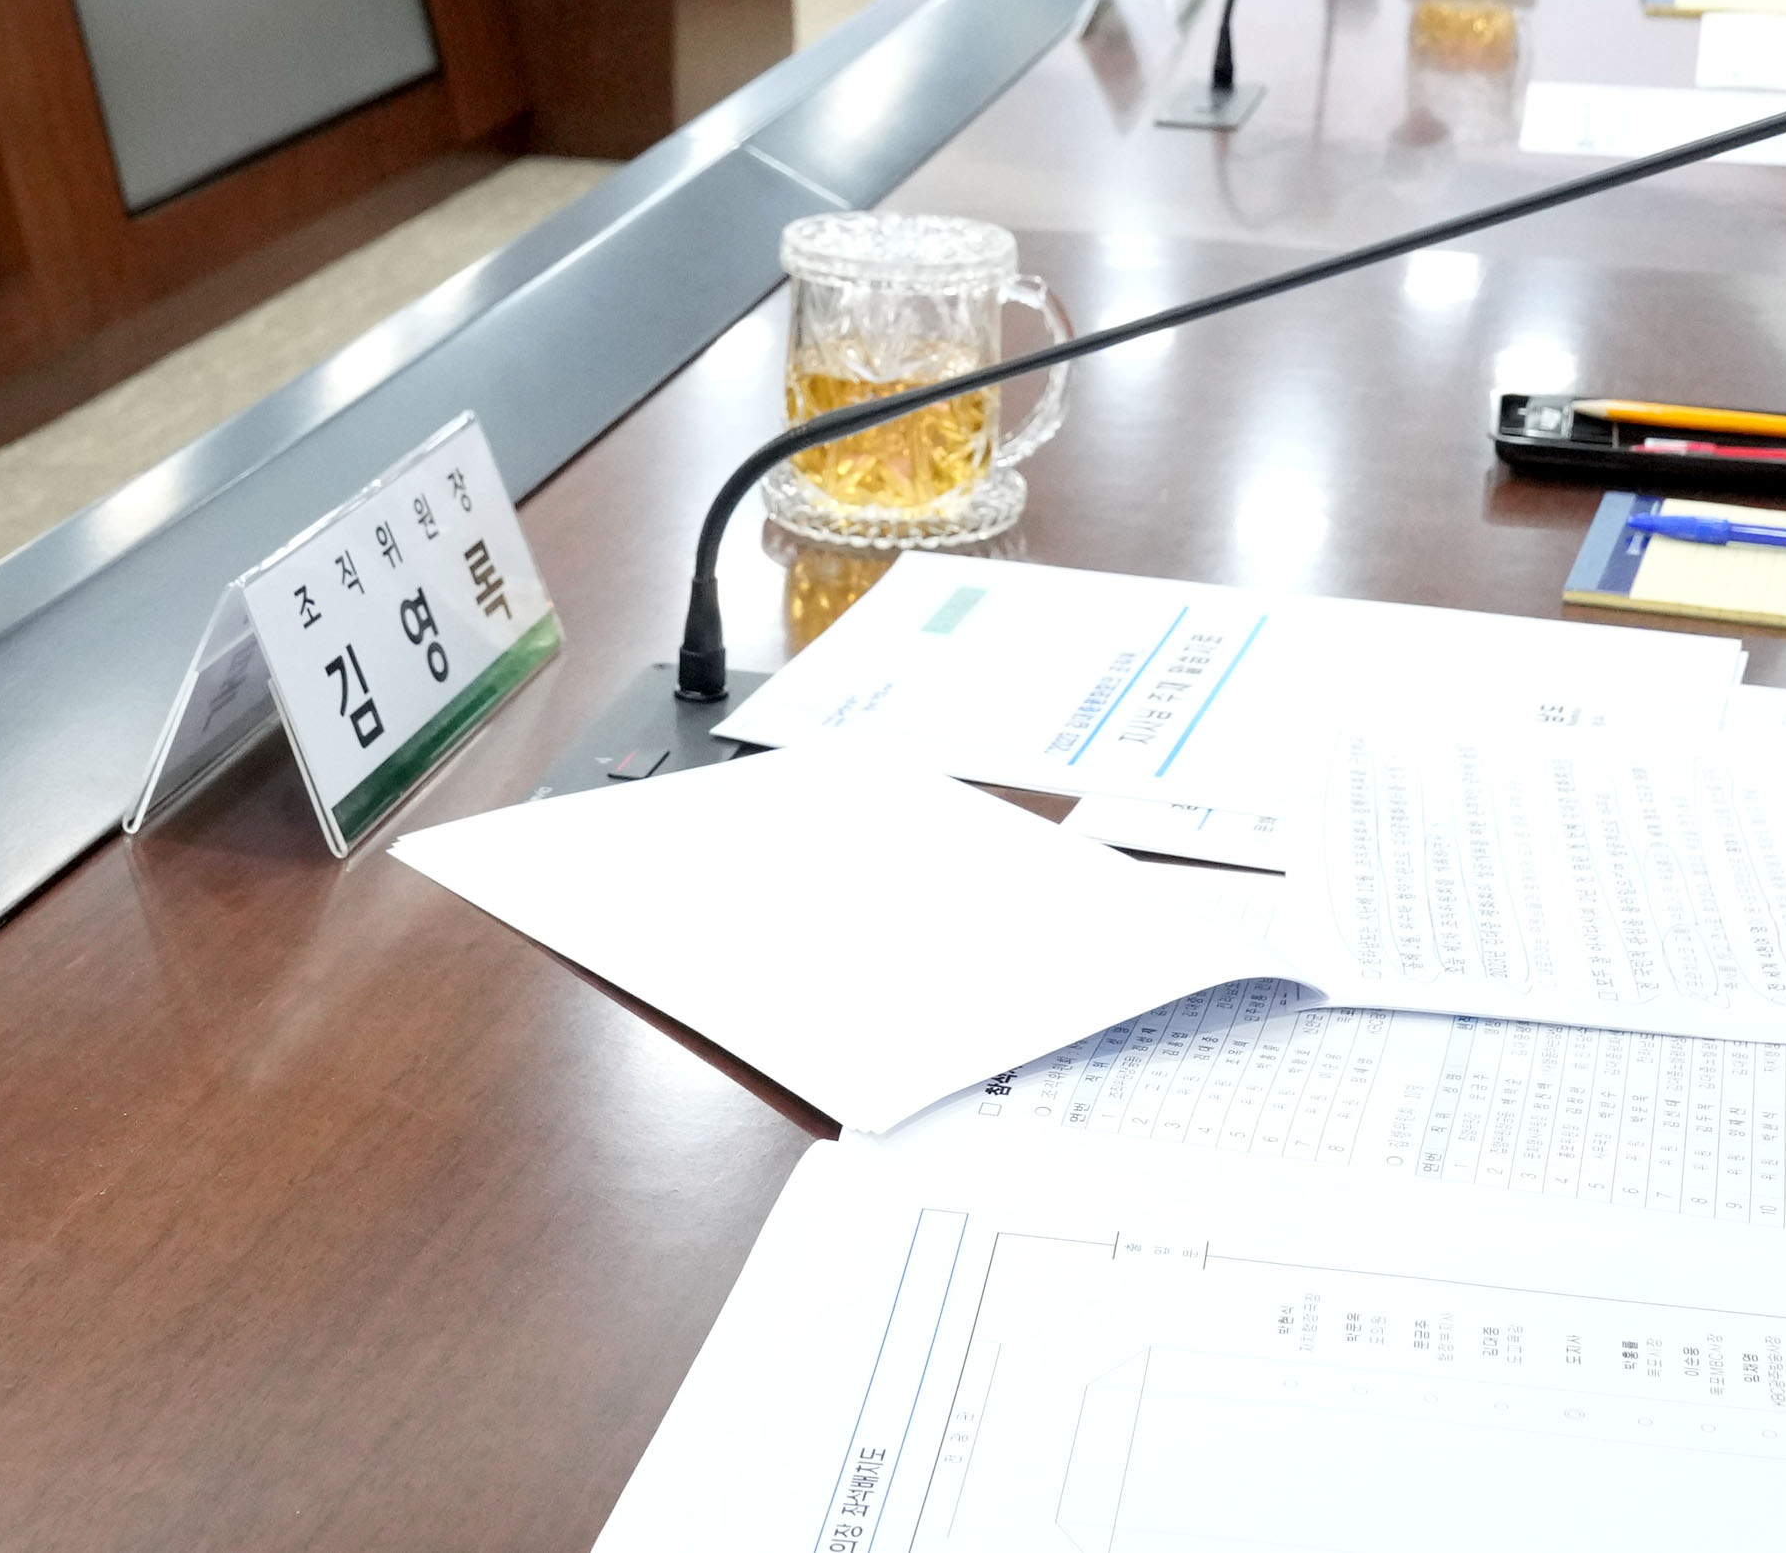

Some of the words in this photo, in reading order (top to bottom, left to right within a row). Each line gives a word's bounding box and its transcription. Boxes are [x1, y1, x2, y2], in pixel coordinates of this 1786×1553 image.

[1193, 1035, 1219, 1061] 김대중
[1069, 1103, 1091, 1123] 연번
[1422, 1152, 1442, 1173] 연번
[1622, 1187, 1639, 1195] 6
[1691, 1197, 1707, 1205] 8
[1725, 1202, 1742, 1210] 9
[1759, 1206, 1778, 1215] 10
[841, 1447, 886, 1517] 좌석배치도
